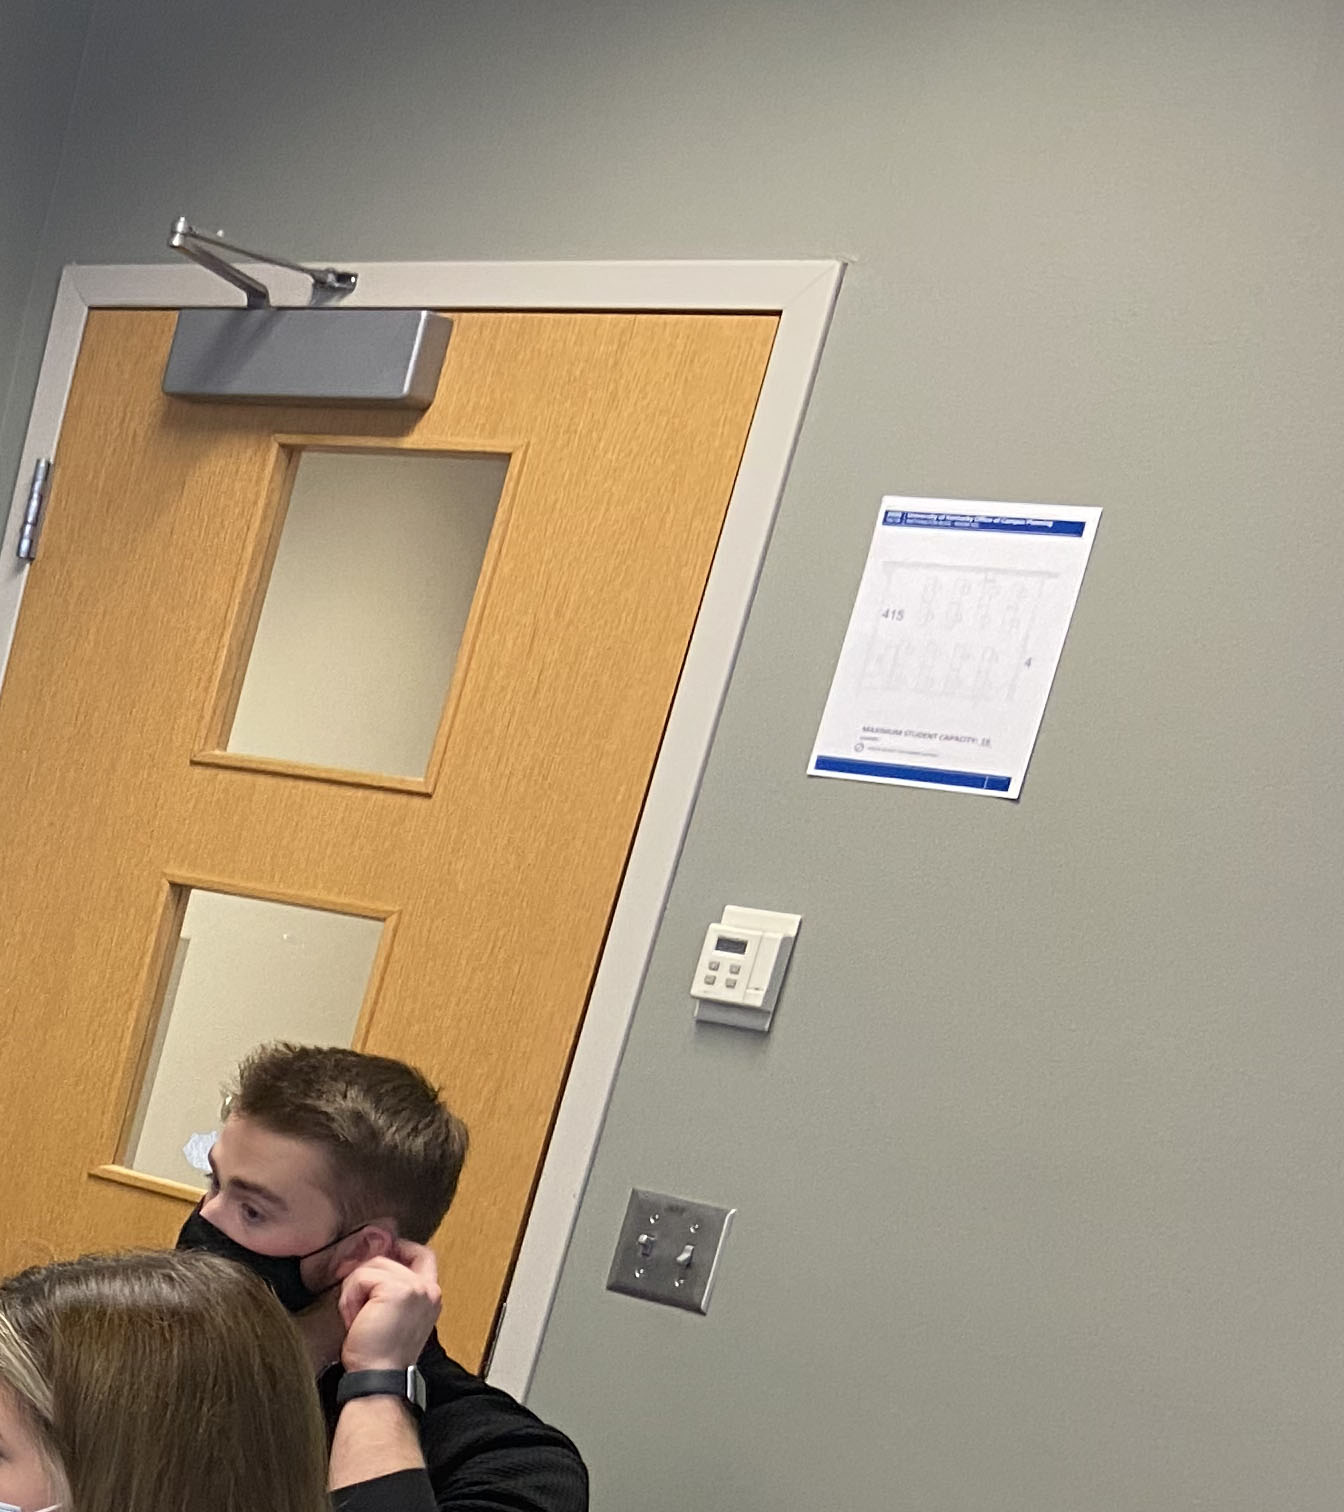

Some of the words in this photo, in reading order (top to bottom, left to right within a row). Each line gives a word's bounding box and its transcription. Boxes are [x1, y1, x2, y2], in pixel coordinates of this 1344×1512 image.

[881, 608, 905, 621] 415
[862, 725, 903, 736] MAXIMUM
[904, 729, 938, 740] STUDENT
